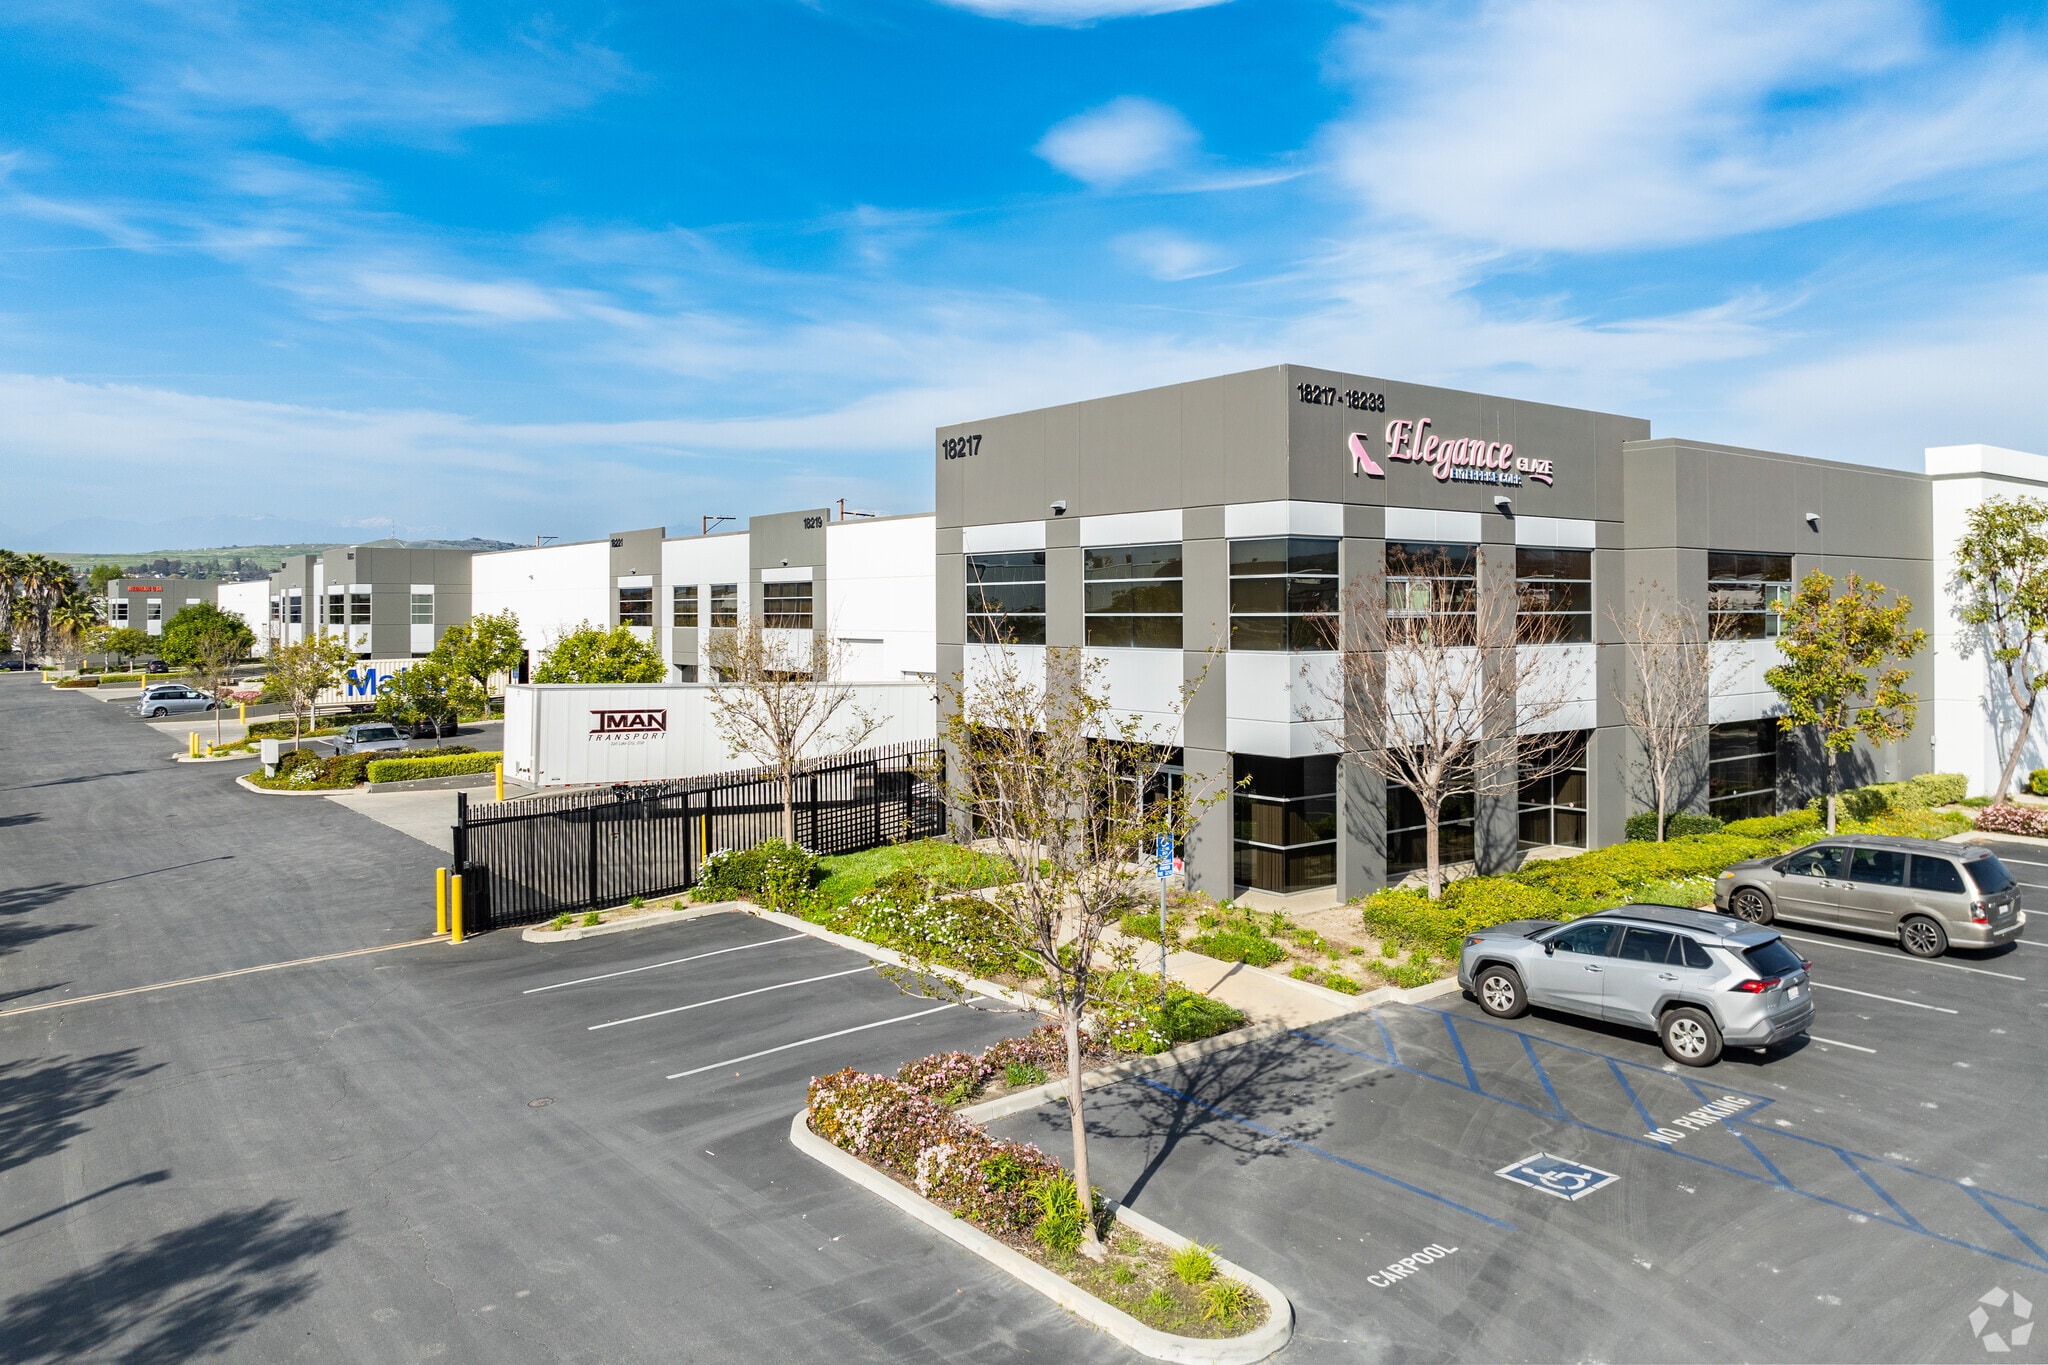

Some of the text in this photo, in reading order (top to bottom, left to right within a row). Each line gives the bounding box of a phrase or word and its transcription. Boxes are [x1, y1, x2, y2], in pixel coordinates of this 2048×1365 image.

[1297, 382, 1337, 406] 18217
[1345, 389, 1386, 413] 18233
[942, 434, 983, 460] 18217
[1385, 417, 1553, 480] Elegance GLAZE
[1450, 467, 1499, 483] ENTERPRISE
[803, 516, 823, 529] 18219
[588, 732, 666, 742] TRANSPORT
[1643, 1095, 1752, 1145] NO PARKING
[1366, 1243, 1459, 1288] CARPOOL
